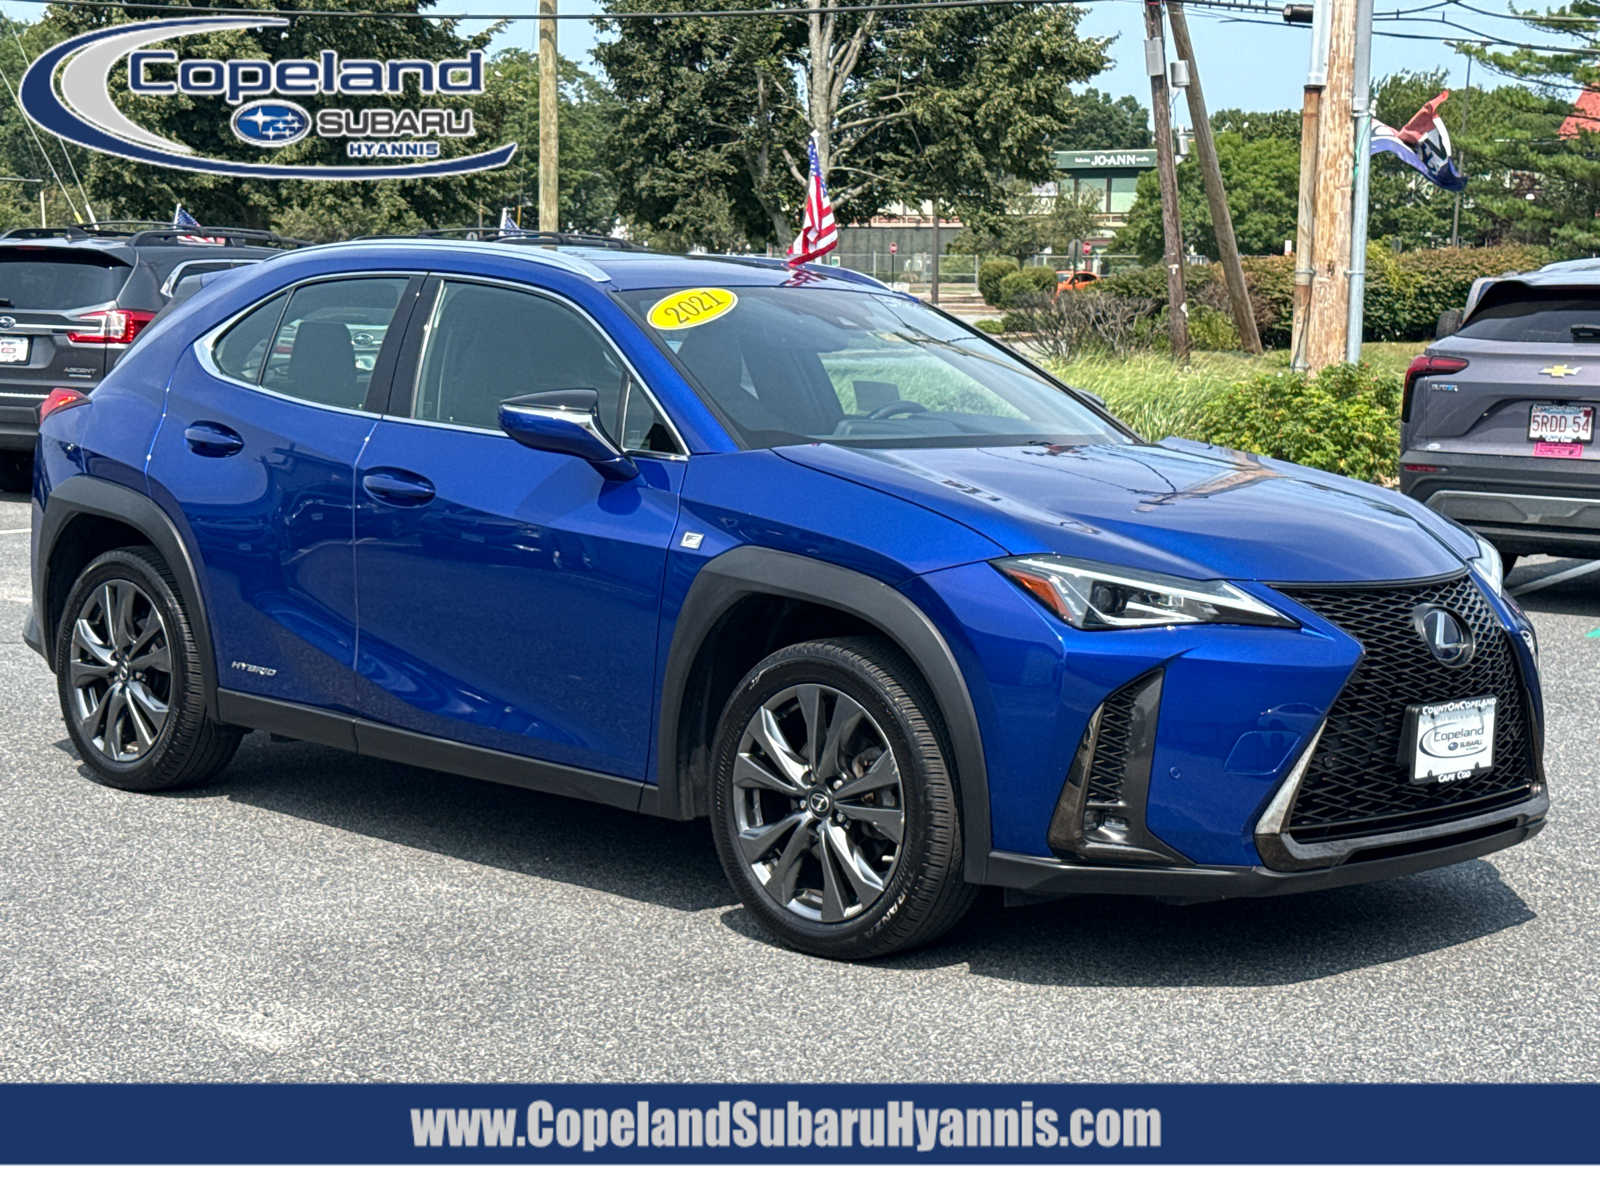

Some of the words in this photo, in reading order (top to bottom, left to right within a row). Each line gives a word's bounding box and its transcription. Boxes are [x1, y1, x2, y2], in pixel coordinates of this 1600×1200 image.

[664, 291, 728, 324] 2021
[1531, 414, 1568, 433] 5RDD
[232, 661, 277, 676] HYBRID
[1434, 727, 1484, 743] Copeland
